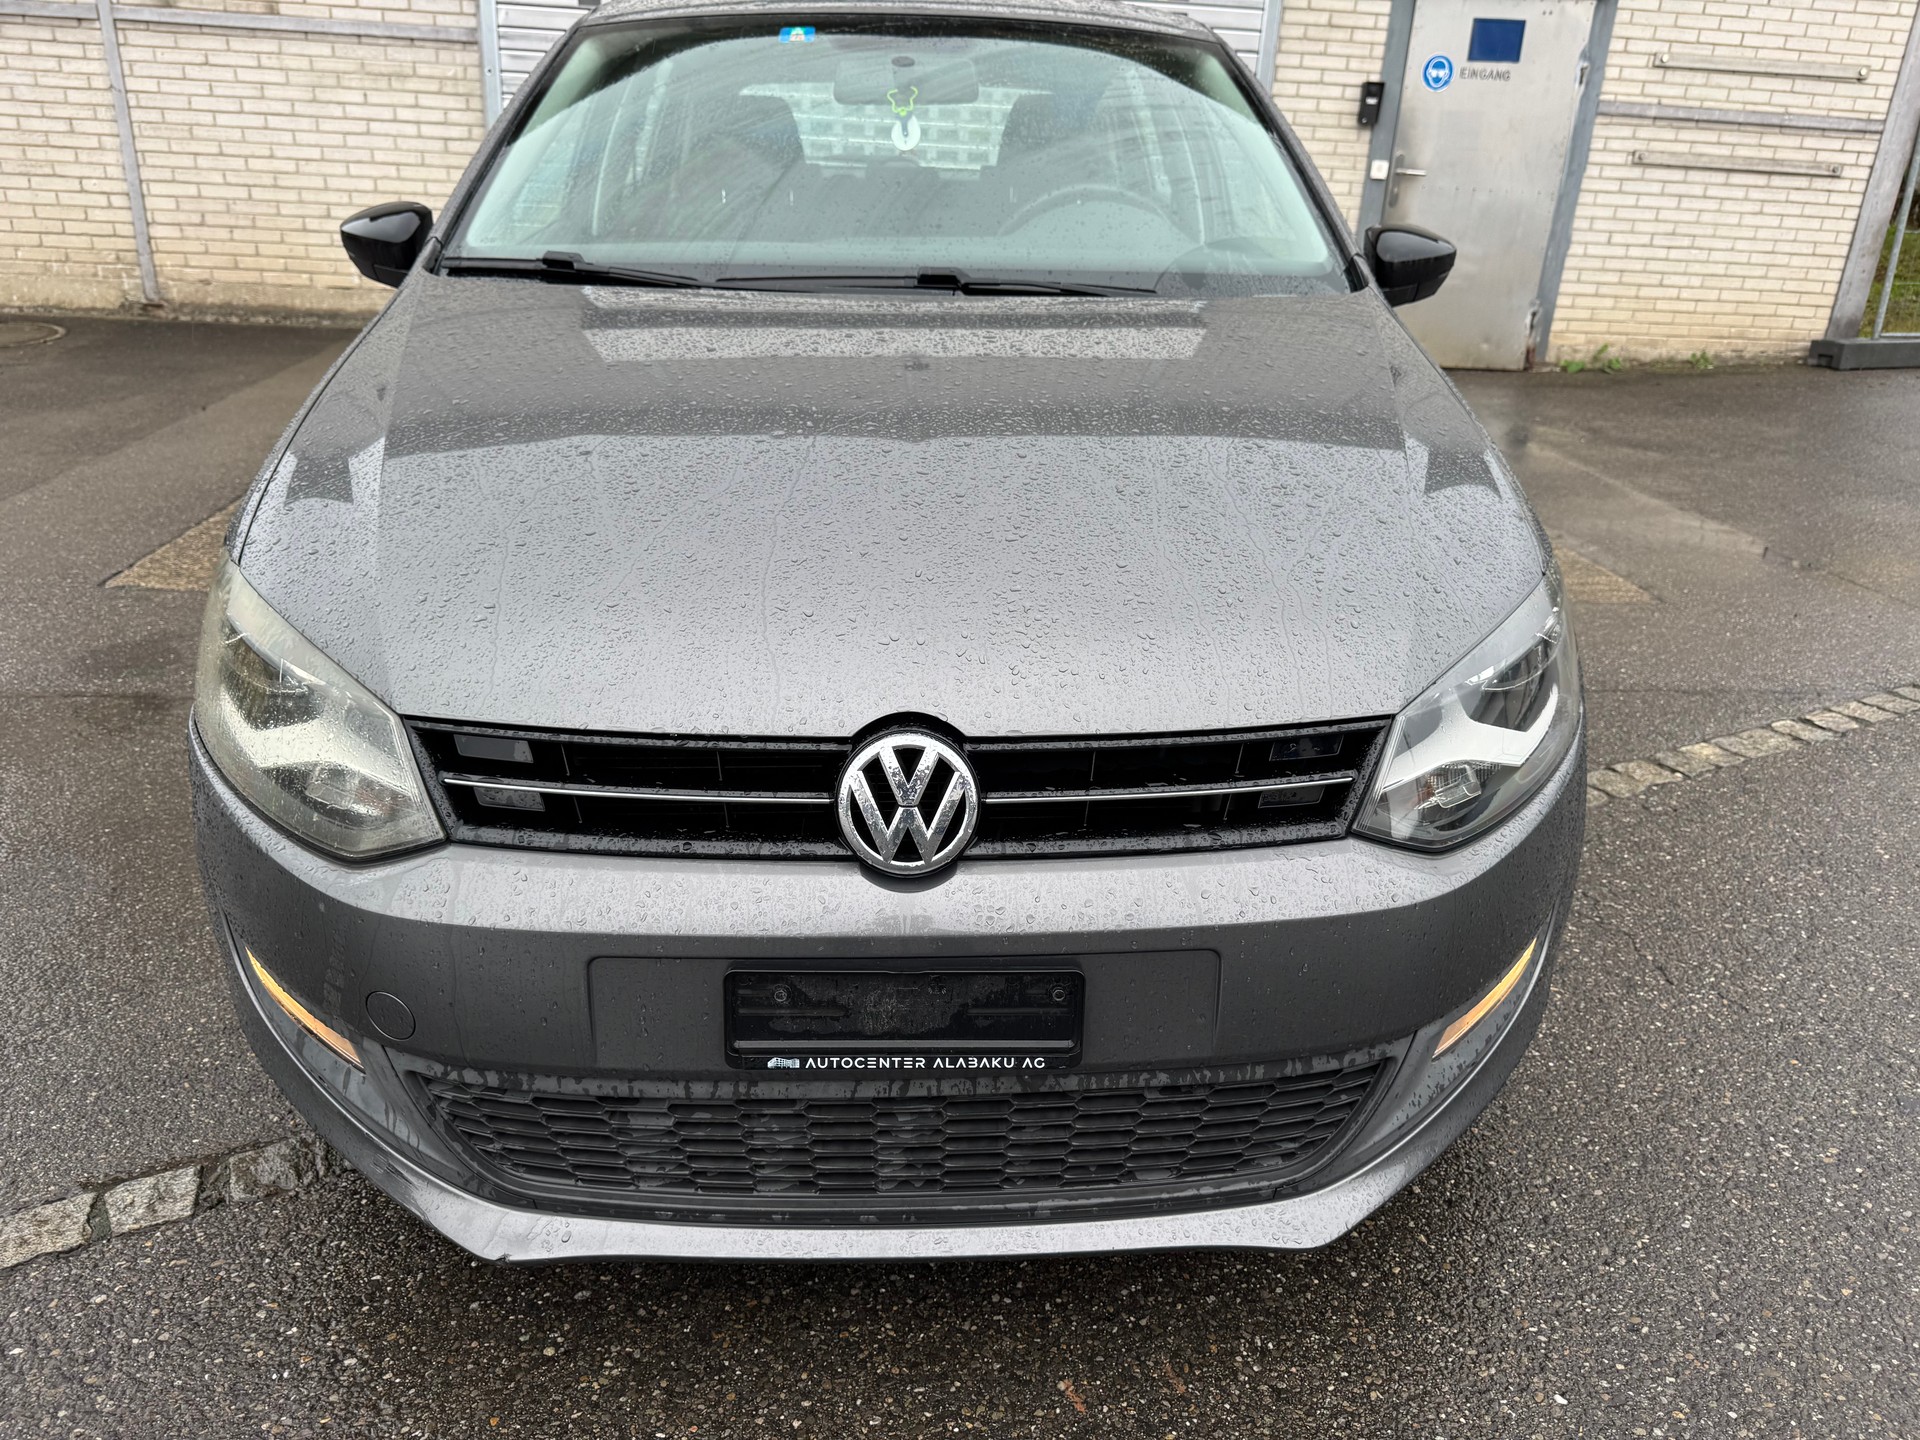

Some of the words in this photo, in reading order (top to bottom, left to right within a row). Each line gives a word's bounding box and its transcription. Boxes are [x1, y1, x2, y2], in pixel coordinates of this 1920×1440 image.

[1459, 66, 1511, 81] EINGANG
[846, 742, 969, 866] VW
[805, 1057, 926, 1069] AUTOCENTER
[933, 1057, 1015, 1069] ALABAKU
[1022, 1057, 1046, 1069] AG
